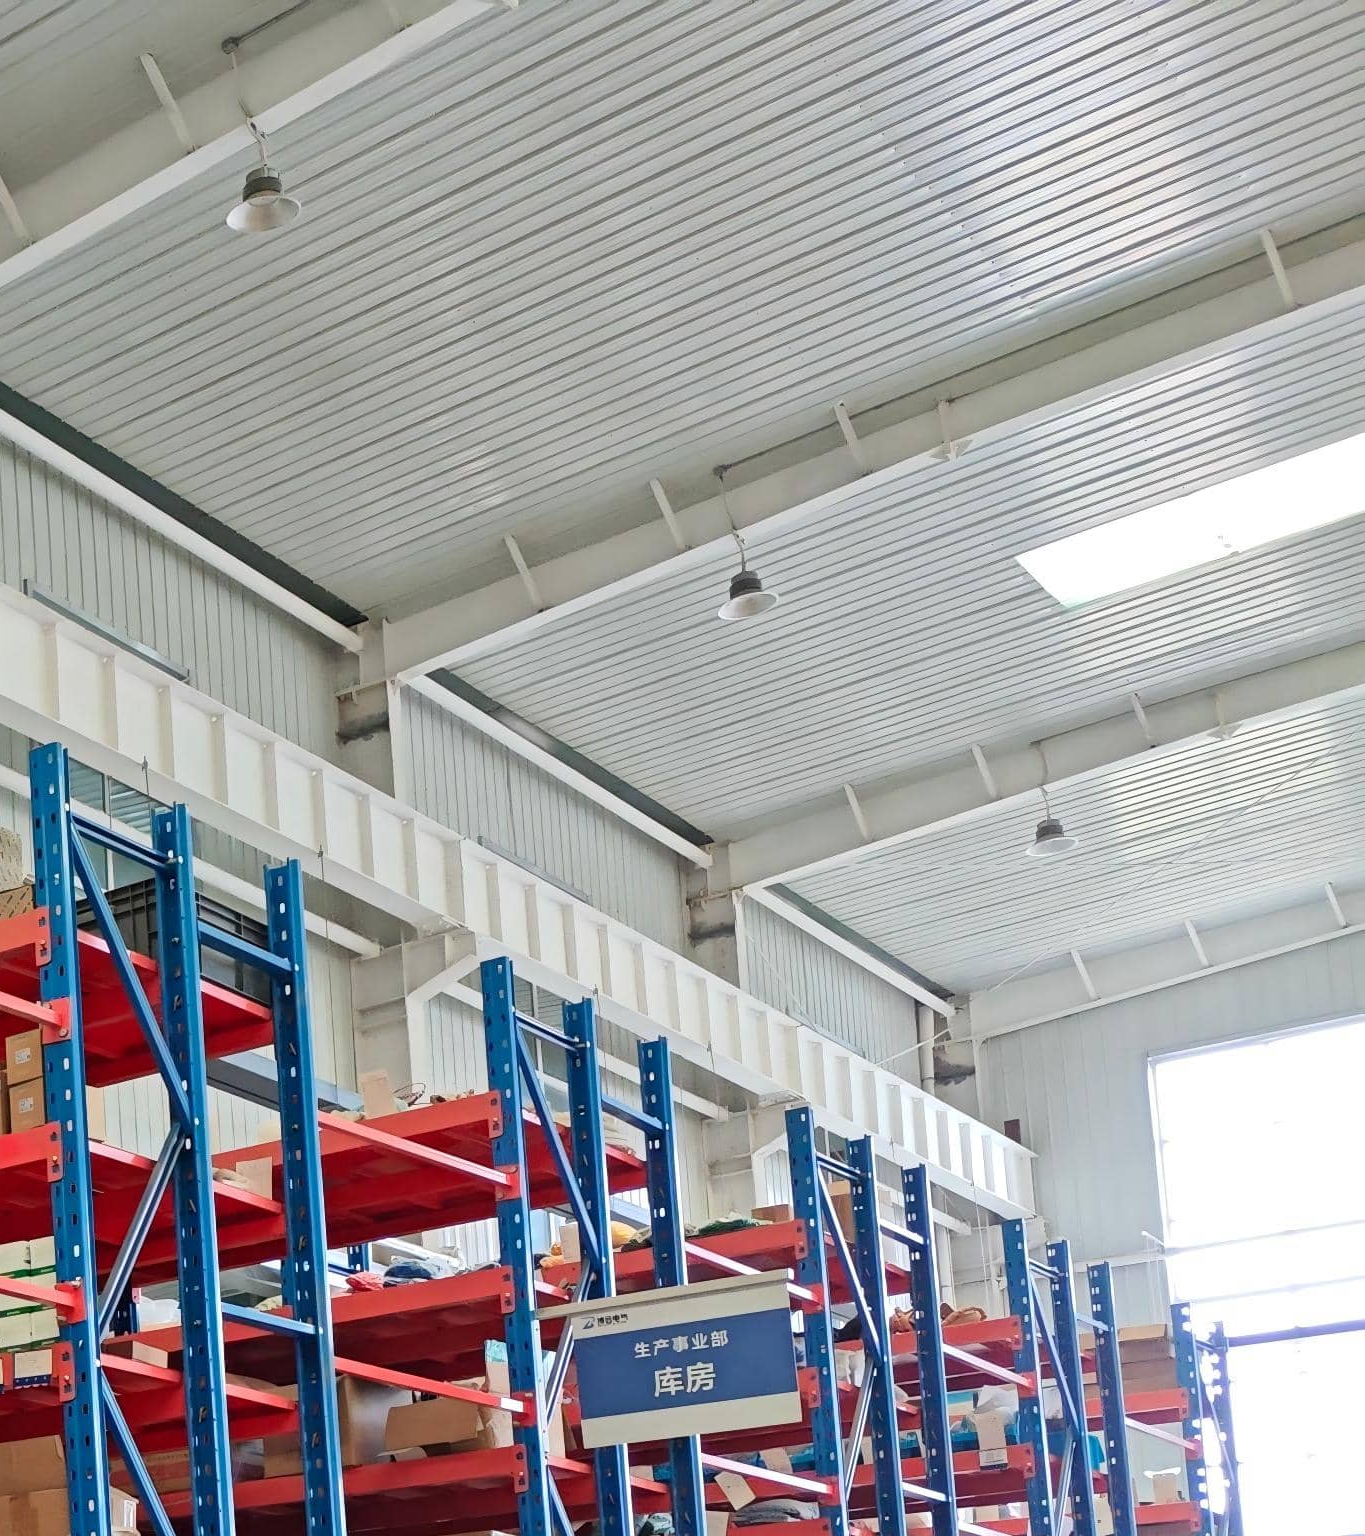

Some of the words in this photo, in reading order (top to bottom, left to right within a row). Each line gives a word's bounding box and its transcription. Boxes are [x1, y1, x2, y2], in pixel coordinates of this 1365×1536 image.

[634, 1330, 729, 1359] 生产事业部
[654, 1362, 716, 1398] 库房
